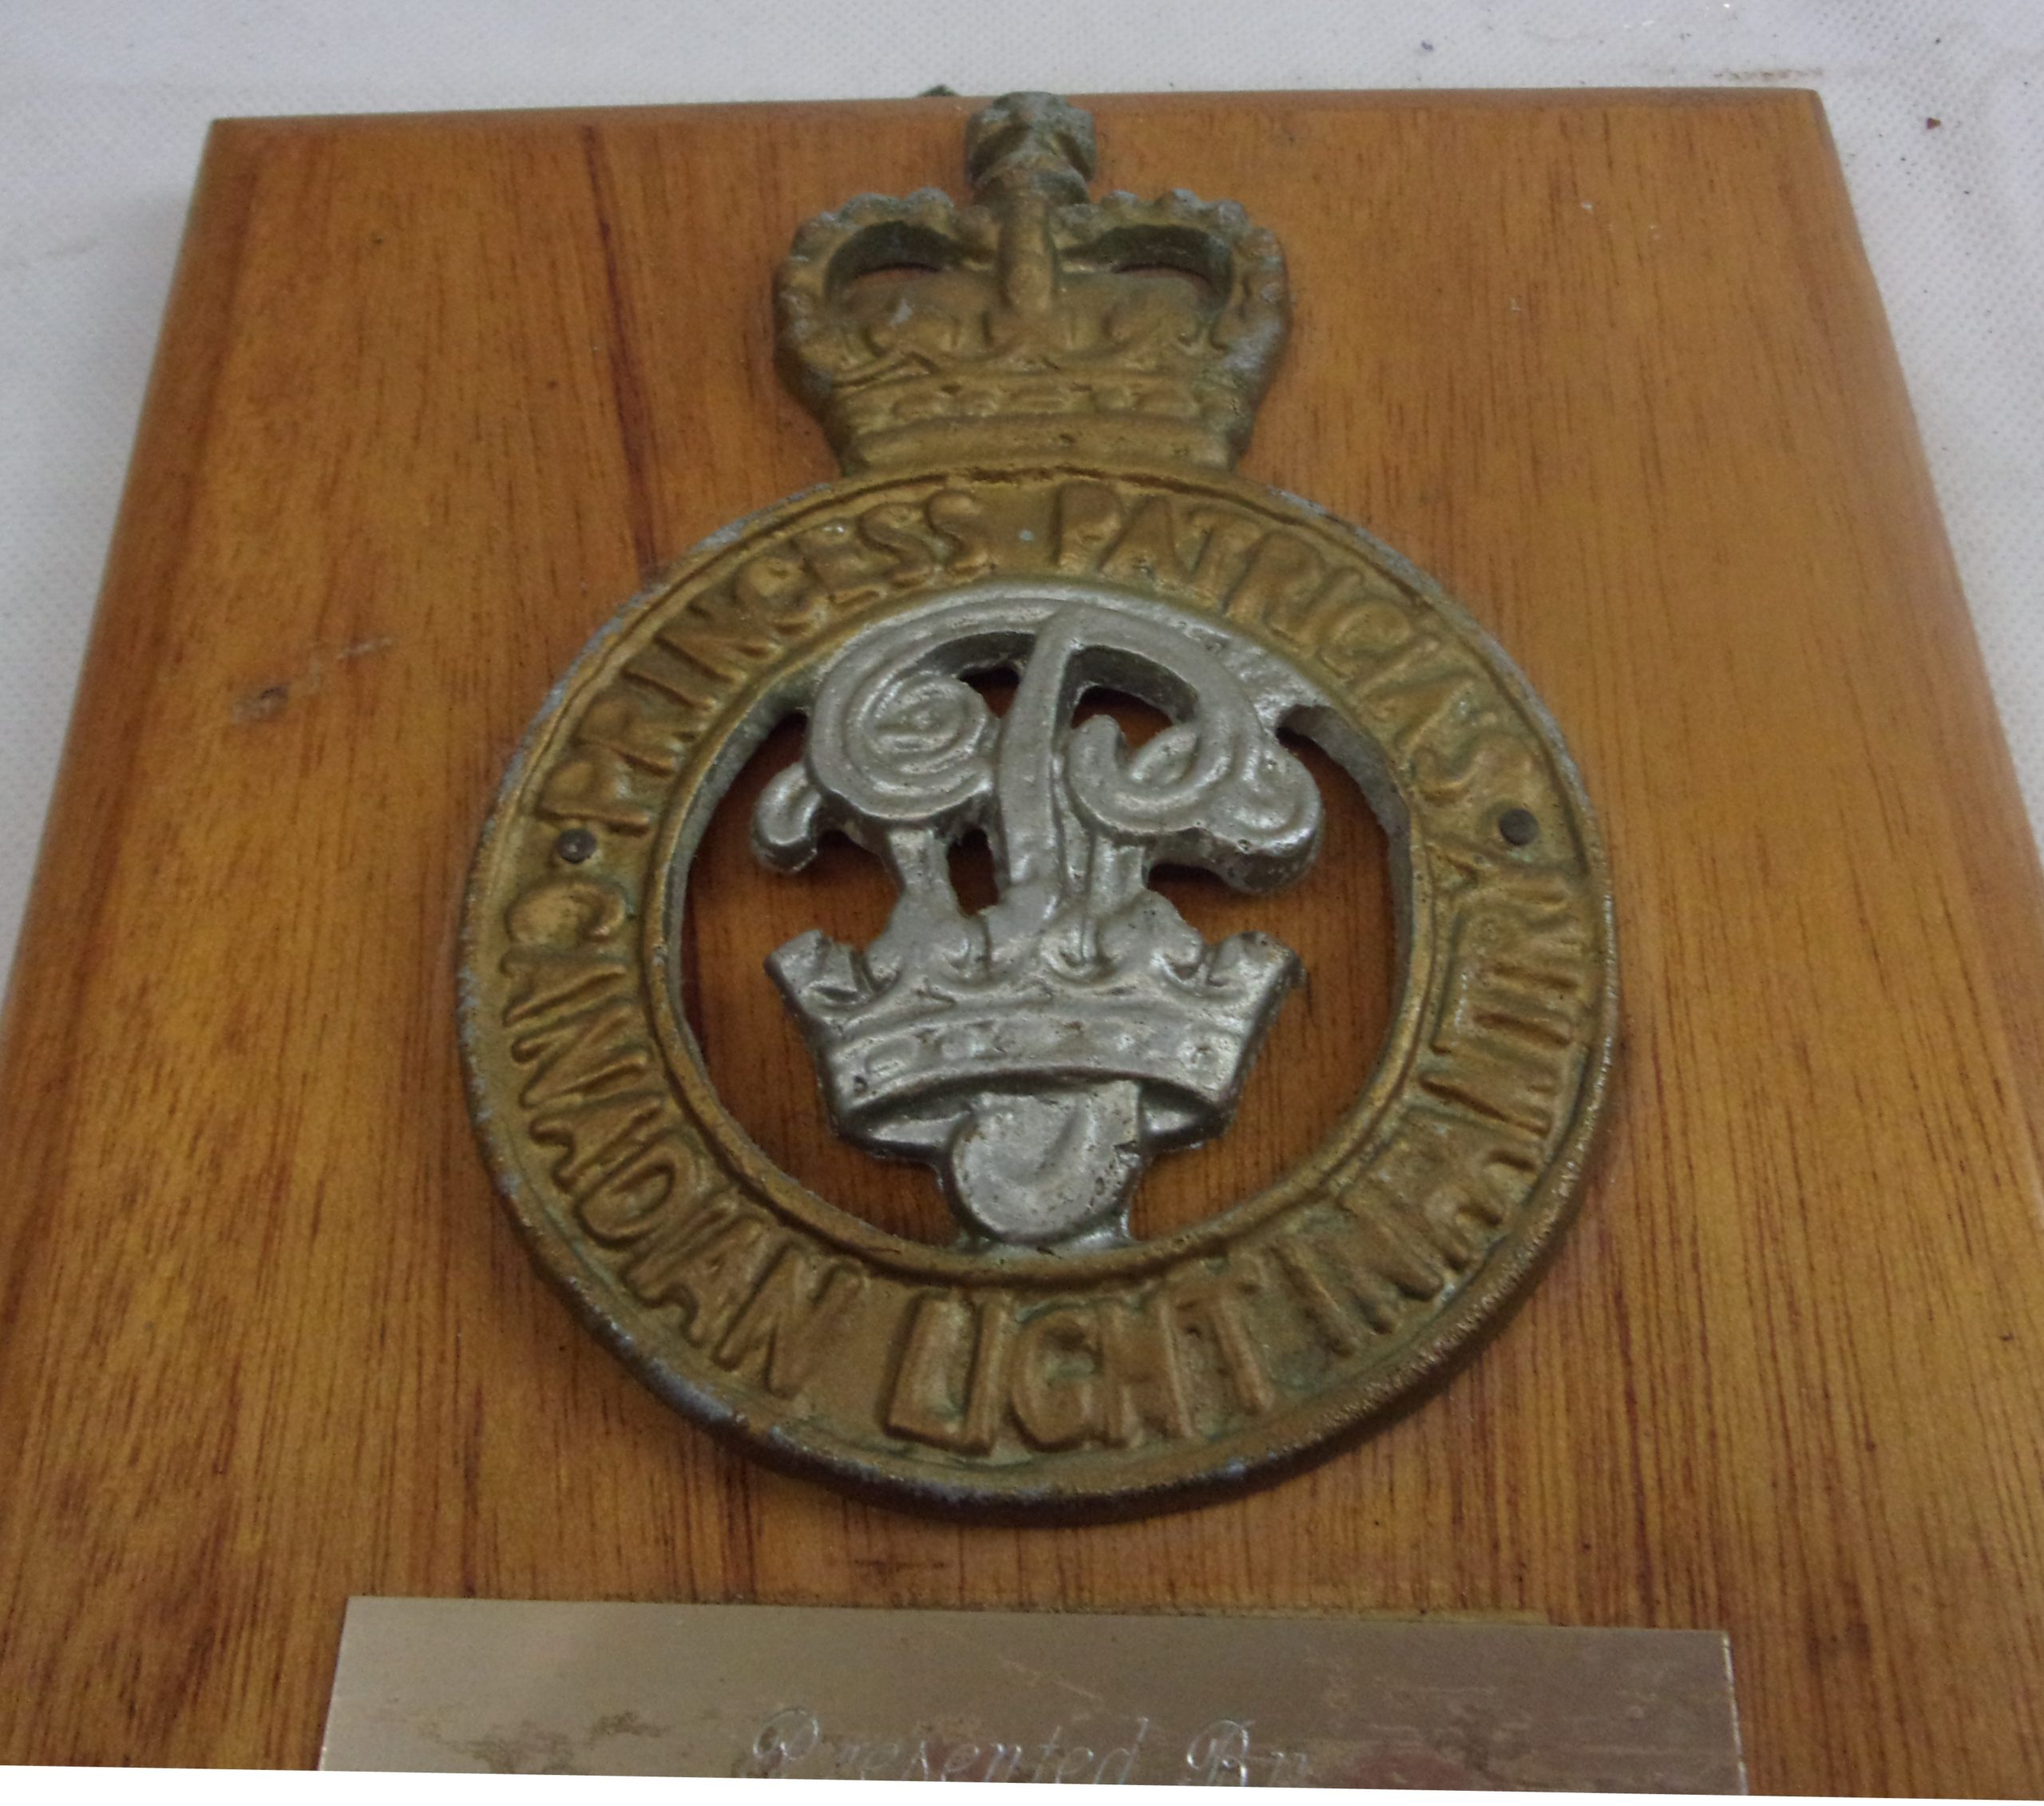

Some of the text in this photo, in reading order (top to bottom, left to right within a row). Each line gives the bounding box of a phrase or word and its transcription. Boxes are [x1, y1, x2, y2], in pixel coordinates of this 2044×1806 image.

[537, 489, 990, 835] PRINCESS
[497, 840, 1585, 1458] CANADIAN LIGHT INFANTRY
